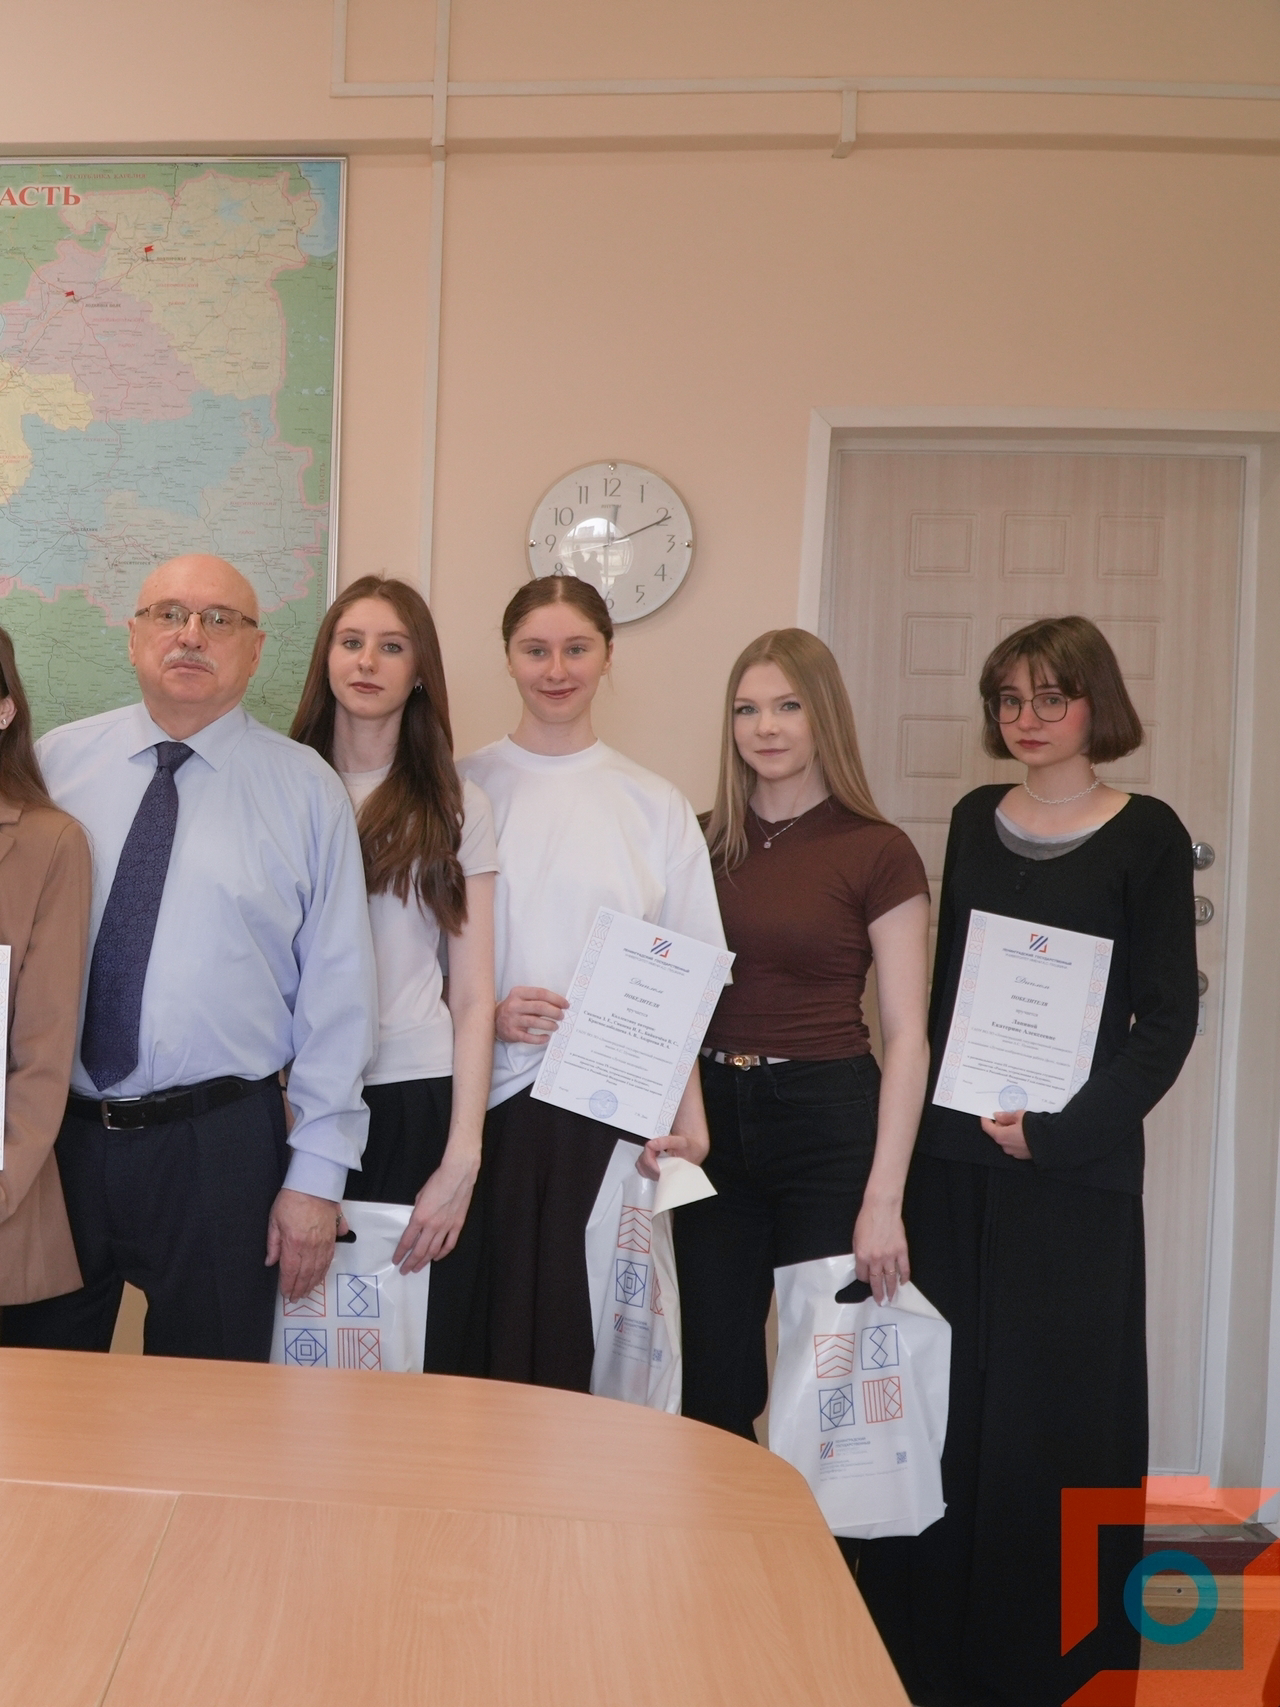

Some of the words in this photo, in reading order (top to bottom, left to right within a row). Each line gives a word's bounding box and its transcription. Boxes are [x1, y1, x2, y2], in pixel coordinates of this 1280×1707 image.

[578, 485, 589, 504] 11
[603, 478, 621, 497] 12
[640, 484, 645, 503] 1
[554, 507, 574, 526] 10
[656, 507, 669, 527] 2
[545, 534, 557, 553] 9
[666, 534, 676, 553] 3
[553, 562, 564, 576] 8
[654, 563, 667, 582] 4
[604, 590, 615, 610] 6
[635, 584, 646, 603] 5
